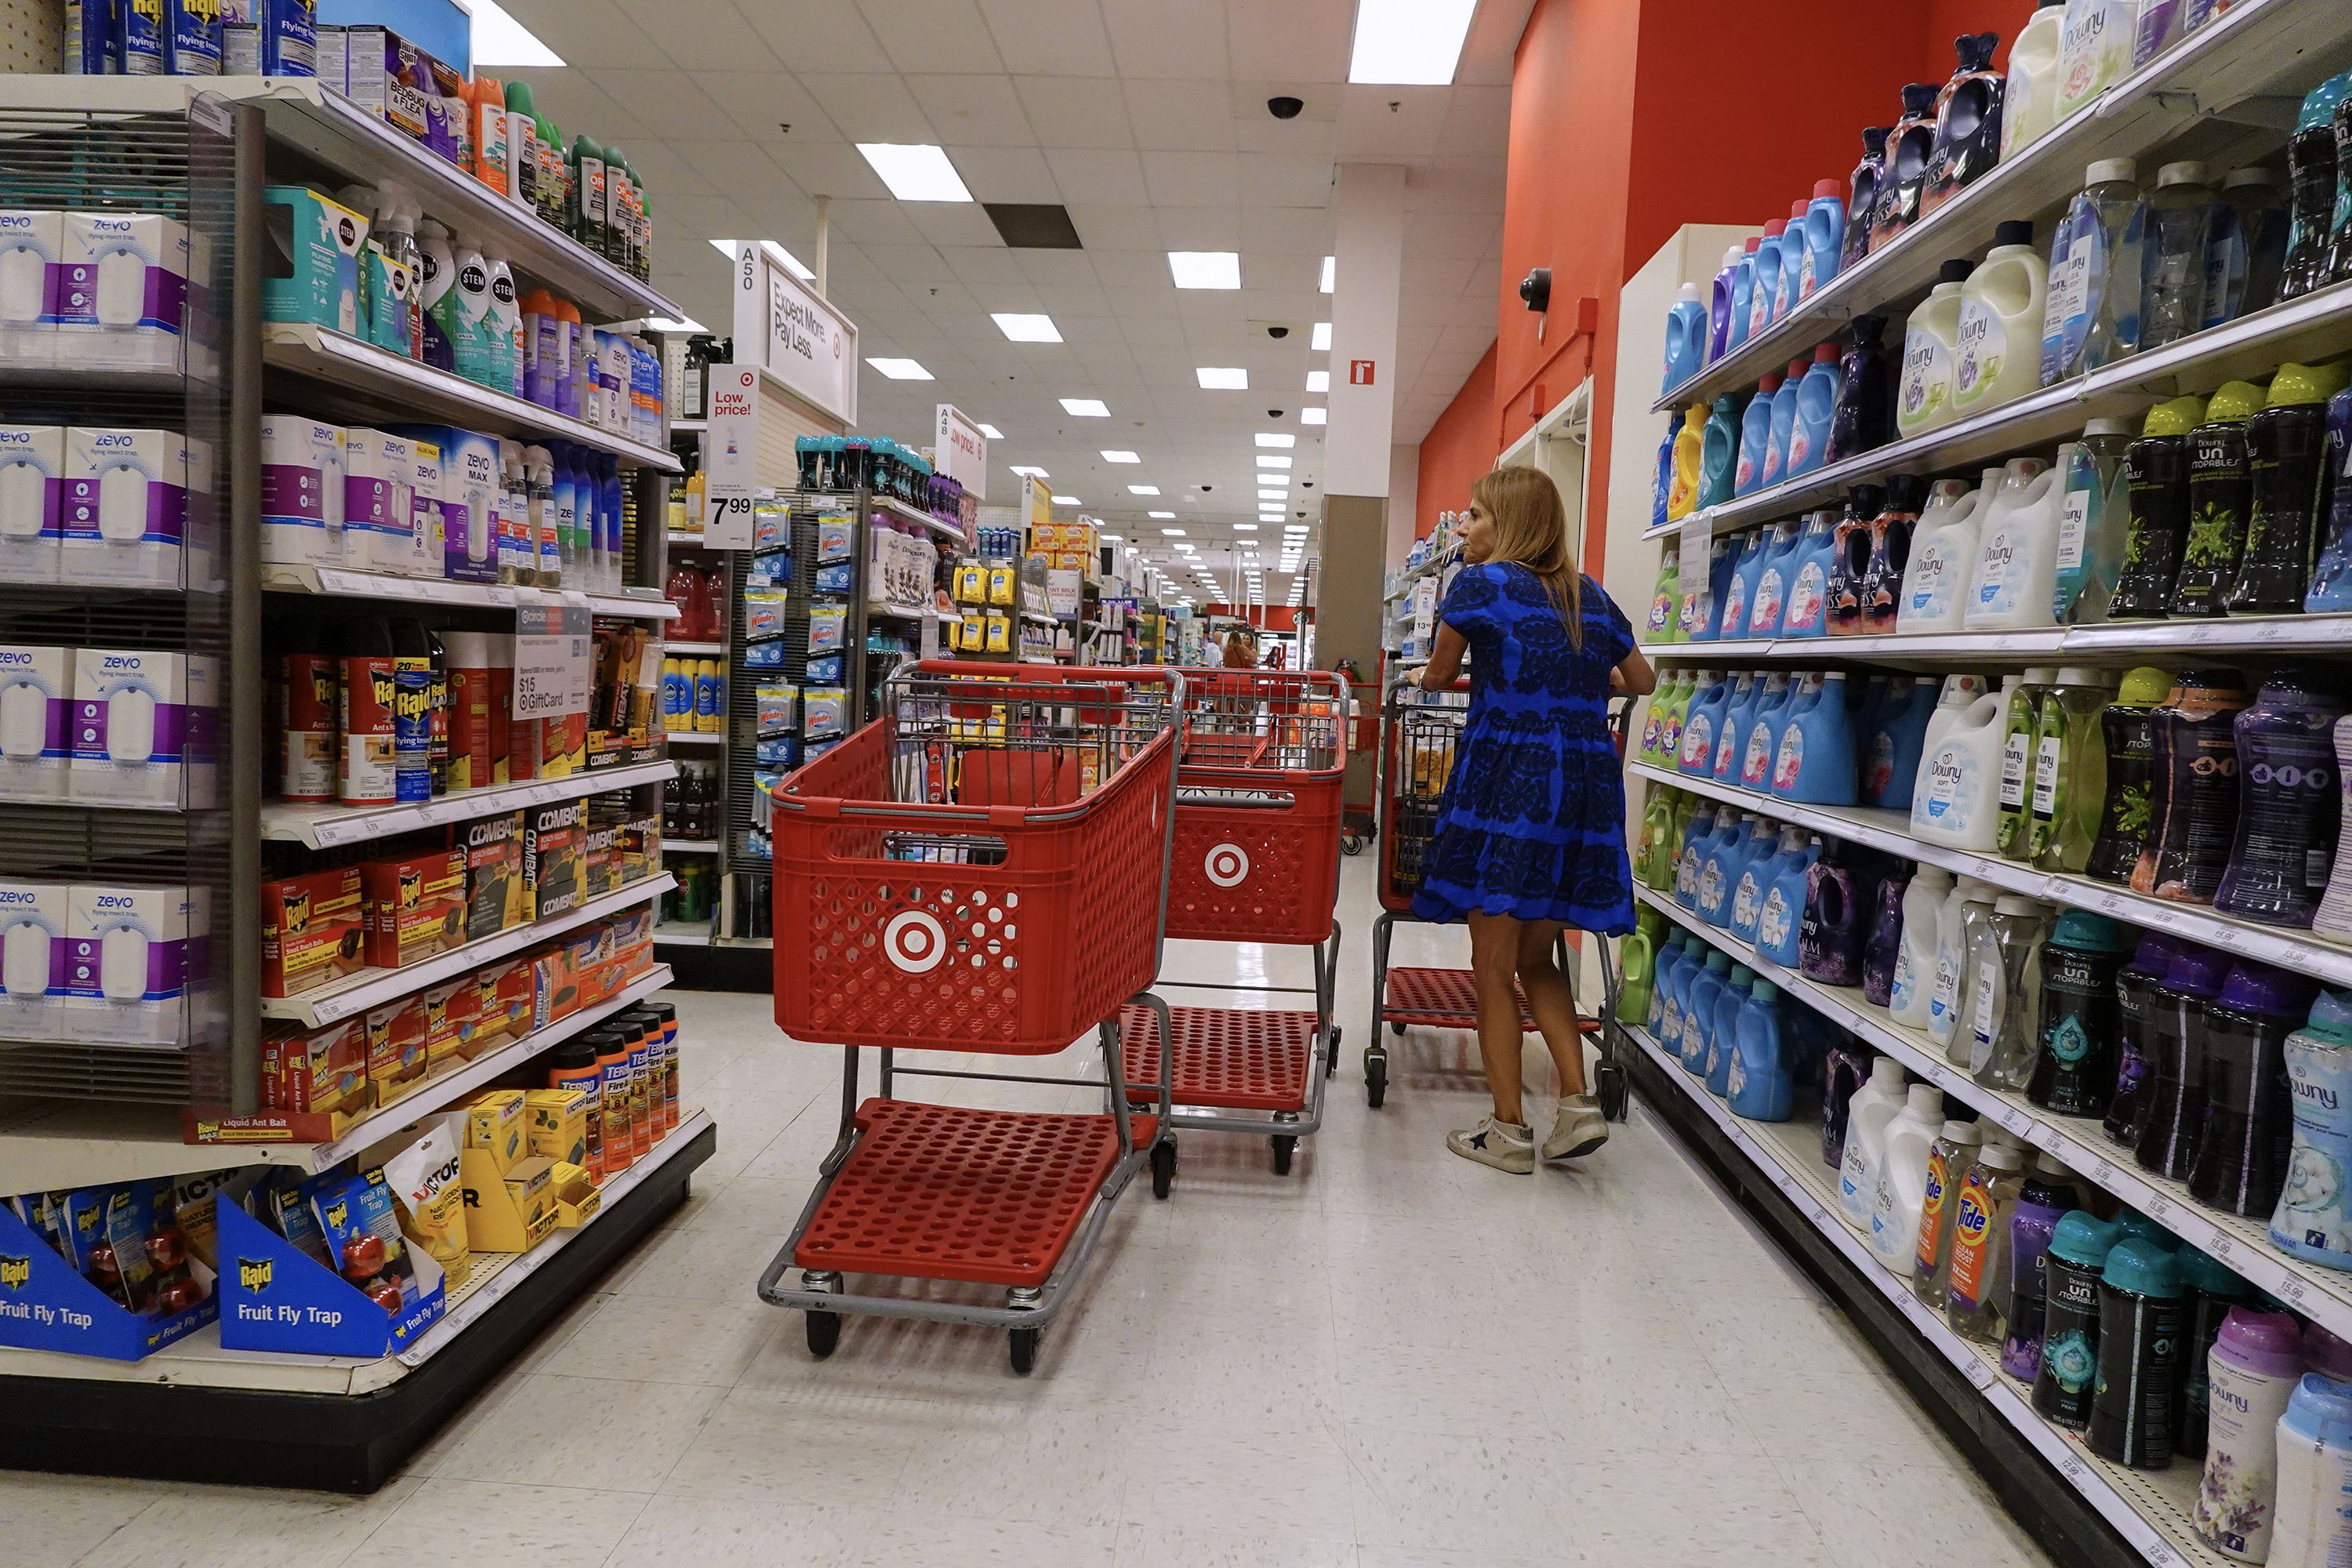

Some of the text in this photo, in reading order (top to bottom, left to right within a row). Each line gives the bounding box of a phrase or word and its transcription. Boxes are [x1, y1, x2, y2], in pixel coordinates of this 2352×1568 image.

[282, 20, 307, 36] Flying
[2065, 8, 2105, 53] Downy
[129, 35, 155, 48] Flying
[178, 34, 204, 48] Flying
[401, 40, 416, 53] HOT
[399, 49, 418, 65] SHOT
[390, 81, 425, 108] BEDBUG
[394, 95, 421, 117] & FLEA
[93, 219, 131, 232] zevo
[340, 224, 354, 240] STEM
[394, 275, 405, 287] STEM
[463, 273, 485, 287] STEM
[495, 285, 514, 298] STEM
[774, 281, 827, 344] Expect More.
[775, 313, 814, 361] Pay Less.
[614, 350, 627, 365] zevo
[715, 391, 743, 404] Low
[715, 404, 751, 417] price!
[95, 434, 133, 447] zevo
[314, 426, 333, 441] zevo
[347, 441, 363, 450] evo
[385, 441, 405, 455] zevo
[467, 452, 489, 470] zevo
[2199, 448, 2223, 460] un
[417, 466, 437, 480] zevo
[468, 471, 488, 483] MAX
[757, 527, 778, 539] Windex
[823, 539, 846, 551] Windex
[1984, 546, 2013, 564] Downy
[1916, 558, 1943, 575] Downy
[751, 615, 778, 628] Windex
[812, 630, 835, 641] Windex
[104, 657, 141, 669] zevo
[520, 677, 535, 693] $15
[397, 687, 430, 716] Raid
[528, 691, 564, 710] GiftCard
[760, 713, 784, 724] Windex
[808, 715, 833, 728] Windex
[591, 753, 614, 766] COMBAT
[1932, 760, 1962, 784] Downy
[538, 805, 580, 832] COMBAT
[470, 818, 516, 848] COMBAT
[1, 891, 35, 903] zevo
[401, 875, 421, 907] Raid
[97, 896, 133, 908] zevo
[543, 894, 576, 916] COMBAT
[286, 896, 310, 931] Raid
[2214, 931, 2234, 941] 15.99
[2283, 950, 2307, 961] 15.99
[2064, 960, 2092, 971] Downy
[2064, 967, 2089, 979] un
[633, 1069, 646, 1077] Fire
[562, 1079, 595, 1091] TERRO
[608, 1081, 623, 1091] Fire
[503, 1097, 524, 1117] VICTOR
[615, 1099, 621, 1108] 8
[223, 1117, 249, 1129] Liquid
[1846, 1146, 1865, 1174] Downy
[412, 1156, 459, 1201] VICTOR
[527, 1167, 551, 1189] VICTOR
[2093, 1167, 2110, 1180] 15.99
[360, 1186, 387, 1204] Fruit Fly
[368, 1199, 383, 1210] Trap
[2148, 1200, 2166, 1214] 15.99
[328, 1205, 347, 1229] Raid
[1958, 1200, 1986, 1232] Tide
[529, 1209, 560, 1241] VICTOR
[1956, 1241, 1974, 1258] CLEAN
[2210, 1237, 2230, 1254] 15.99
[1955, 1250, 1973, 1265] BOOST
[2, 1261, 29, 1283] Raid
[240, 1262, 272, 1287] Raid
[2069, 1277, 2093, 1289] Downy
[2280, 1281, 2303, 1299] 15.99
[2058, 1290, 2099, 1305] STOPABLE
[2069, 1285, 2090, 1298] un
[0, 1300, 93, 1330] Fruit Fly Trap
[238, 1304, 342, 1327] Fruit Fly Trap
[407, 1298, 444, 1330] Fruit Fly Trap
[2062, 1460, 2079, 1475] 12.99
[2148, 1545, 2168, 1564] 12.99
